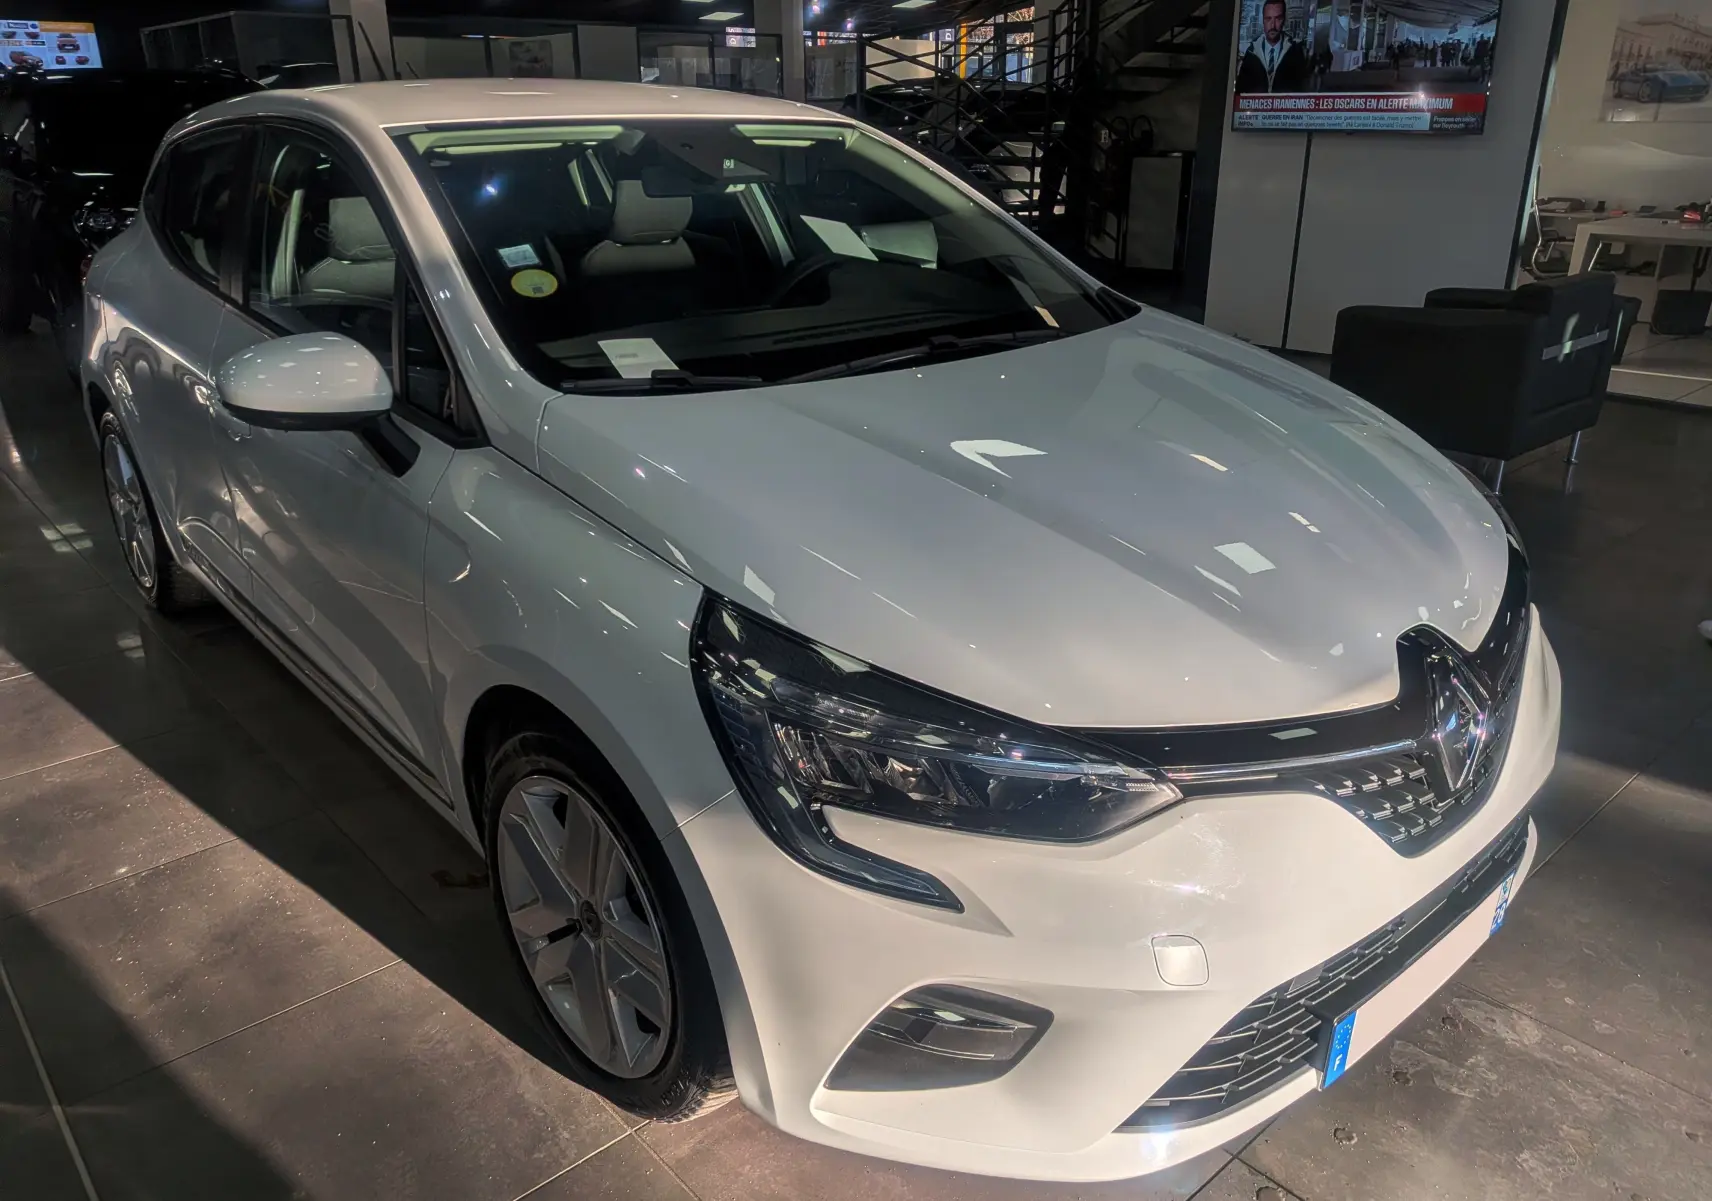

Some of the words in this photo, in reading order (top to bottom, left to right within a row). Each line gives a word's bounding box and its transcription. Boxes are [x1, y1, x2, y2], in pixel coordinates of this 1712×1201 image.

[1239, 98, 1272, 109] MENACES
[1273, 98, 1315, 109] IRANIENNES
[1319, 98, 1333, 109] LES
[1334, 98, 1366, 109] OSCARS
[1366, 98, 1377, 109] EN
[1378, 98, 1409, 109] ALERTE
[1409, 98, 1454, 109] MAXIMUM
[1333, 1054, 1343, 1071] F
